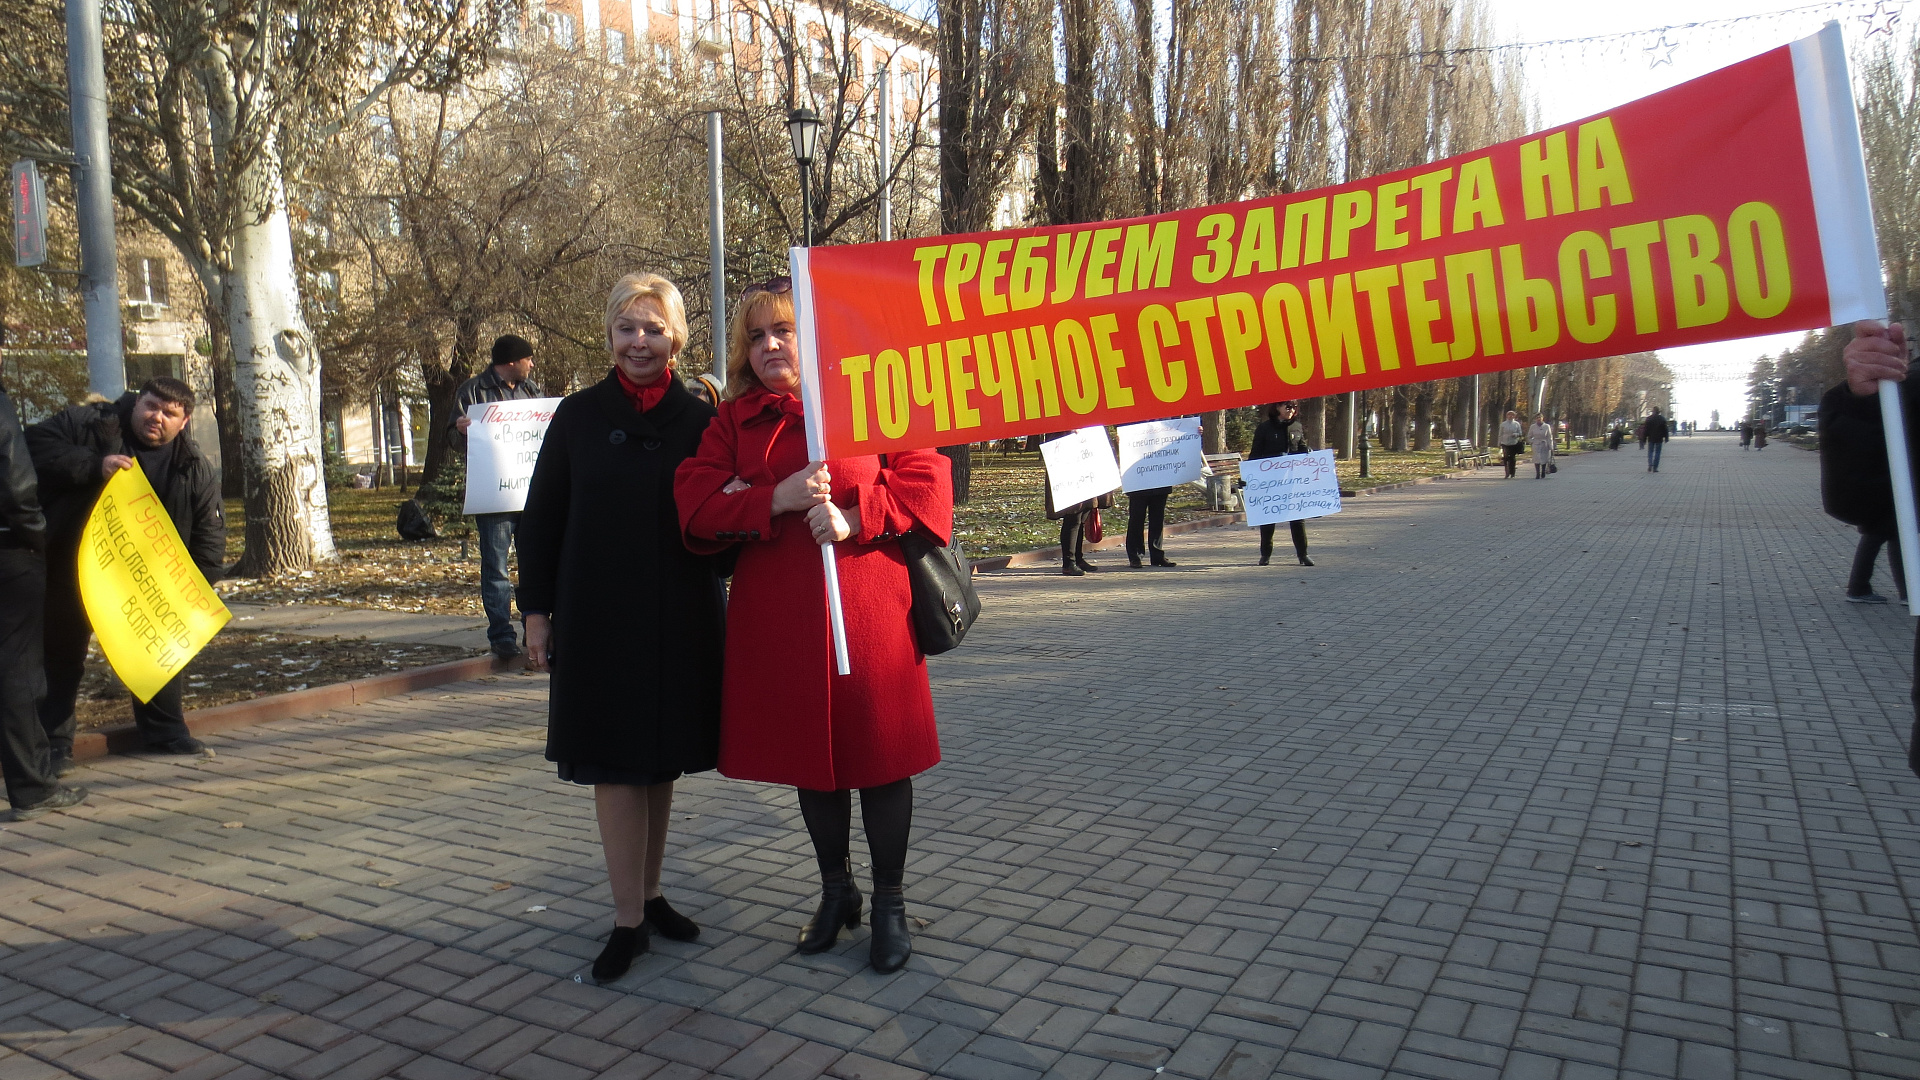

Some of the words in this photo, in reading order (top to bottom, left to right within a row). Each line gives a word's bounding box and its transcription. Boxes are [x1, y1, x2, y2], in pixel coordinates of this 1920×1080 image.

[913, 220, 1179, 326] ТРЕБУЕМ
[1191, 156, 1504, 284] ЗАПРЕТА
[1519, 116, 1633, 221] НА
[841, 312, 1134, 442] ТОЧЕЧНОЕ
[1138, 201, 1792, 403] СТРОИТЕЛЬСТВО
[102, 494, 192, 650] ОБЩЕСТВЕННОСТЬ
[120, 595, 181, 674] ВСТРЕЧИ
